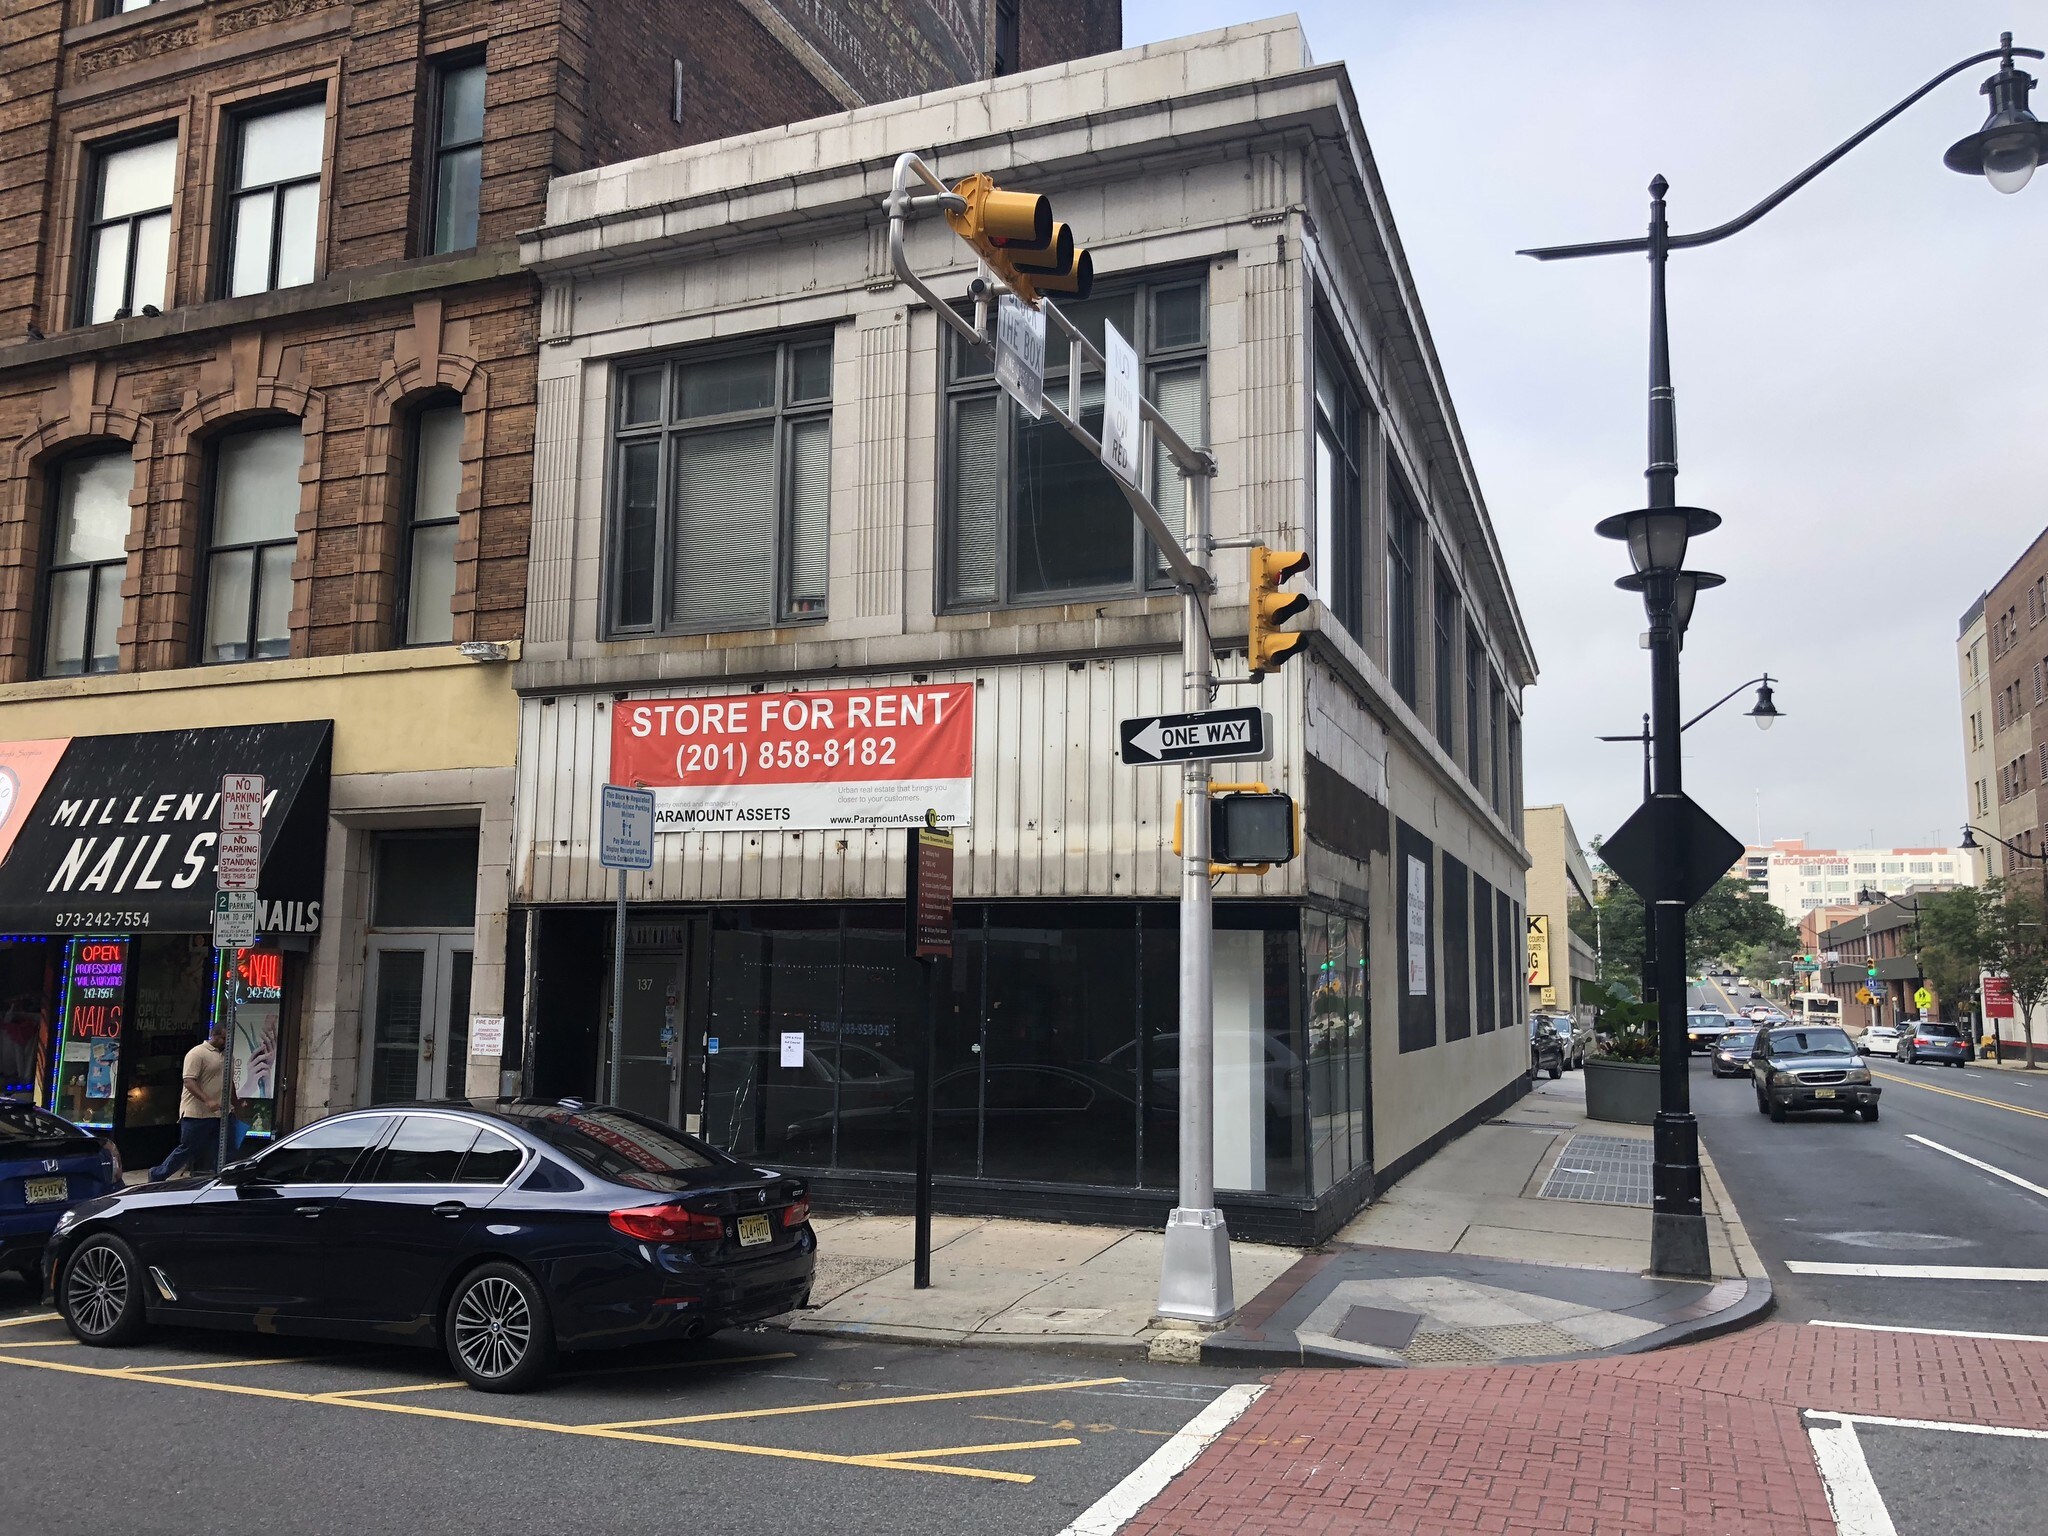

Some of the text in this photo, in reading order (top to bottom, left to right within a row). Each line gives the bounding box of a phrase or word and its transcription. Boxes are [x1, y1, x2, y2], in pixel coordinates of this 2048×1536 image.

[1002, 307, 1019, 351] THE
[1024, 330, 1042, 374] BOX
[1114, 344, 1130, 380] NO
[1112, 377, 1133, 412] TURN
[1116, 409, 1129, 438] ON
[1112, 440, 1128, 469] RED
[631, 692, 950, 738] STORE FOR RENT
[1162, 722, 1247, 748] ONE WAY
[676, 736, 897, 779] (201) 858-8182
[235, 780, 251, 791] NO
[838, 786, 858, 794] Urban
[874, 785, 895, 793] estate
[912, 785, 933, 793] brings
[225, 792, 260, 803] PARKING
[867, 796, 883, 804] your
[692, 800, 703, 808] and
[704, 800, 730, 808] managed
[731, 800, 739, 808] by
[232, 812, 252, 820] TIME
[654, 807, 791, 823] ARAMOUNT ASSETS
[233, 836, 247, 844] NO
[222, 845, 258, 853] PARKING
[221, 858, 257, 866] STANDING
[1773, 857, 1850, 866] RUTGERS-NEWARK
[219, 896, 227, 908] 2
[229, 902, 254, 910] PARKING
[55, 911, 150, 928] 973-242-7554
[241, 912, 253, 920] 6PM
[255, 900, 321, 933] NAILS
[1528, 935, 1545, 943] COURTS
[83, 945, 120, 961] OPEN
[637, 978, 653, 991] 137
[72, 1005, 121, 1038] NAILS
